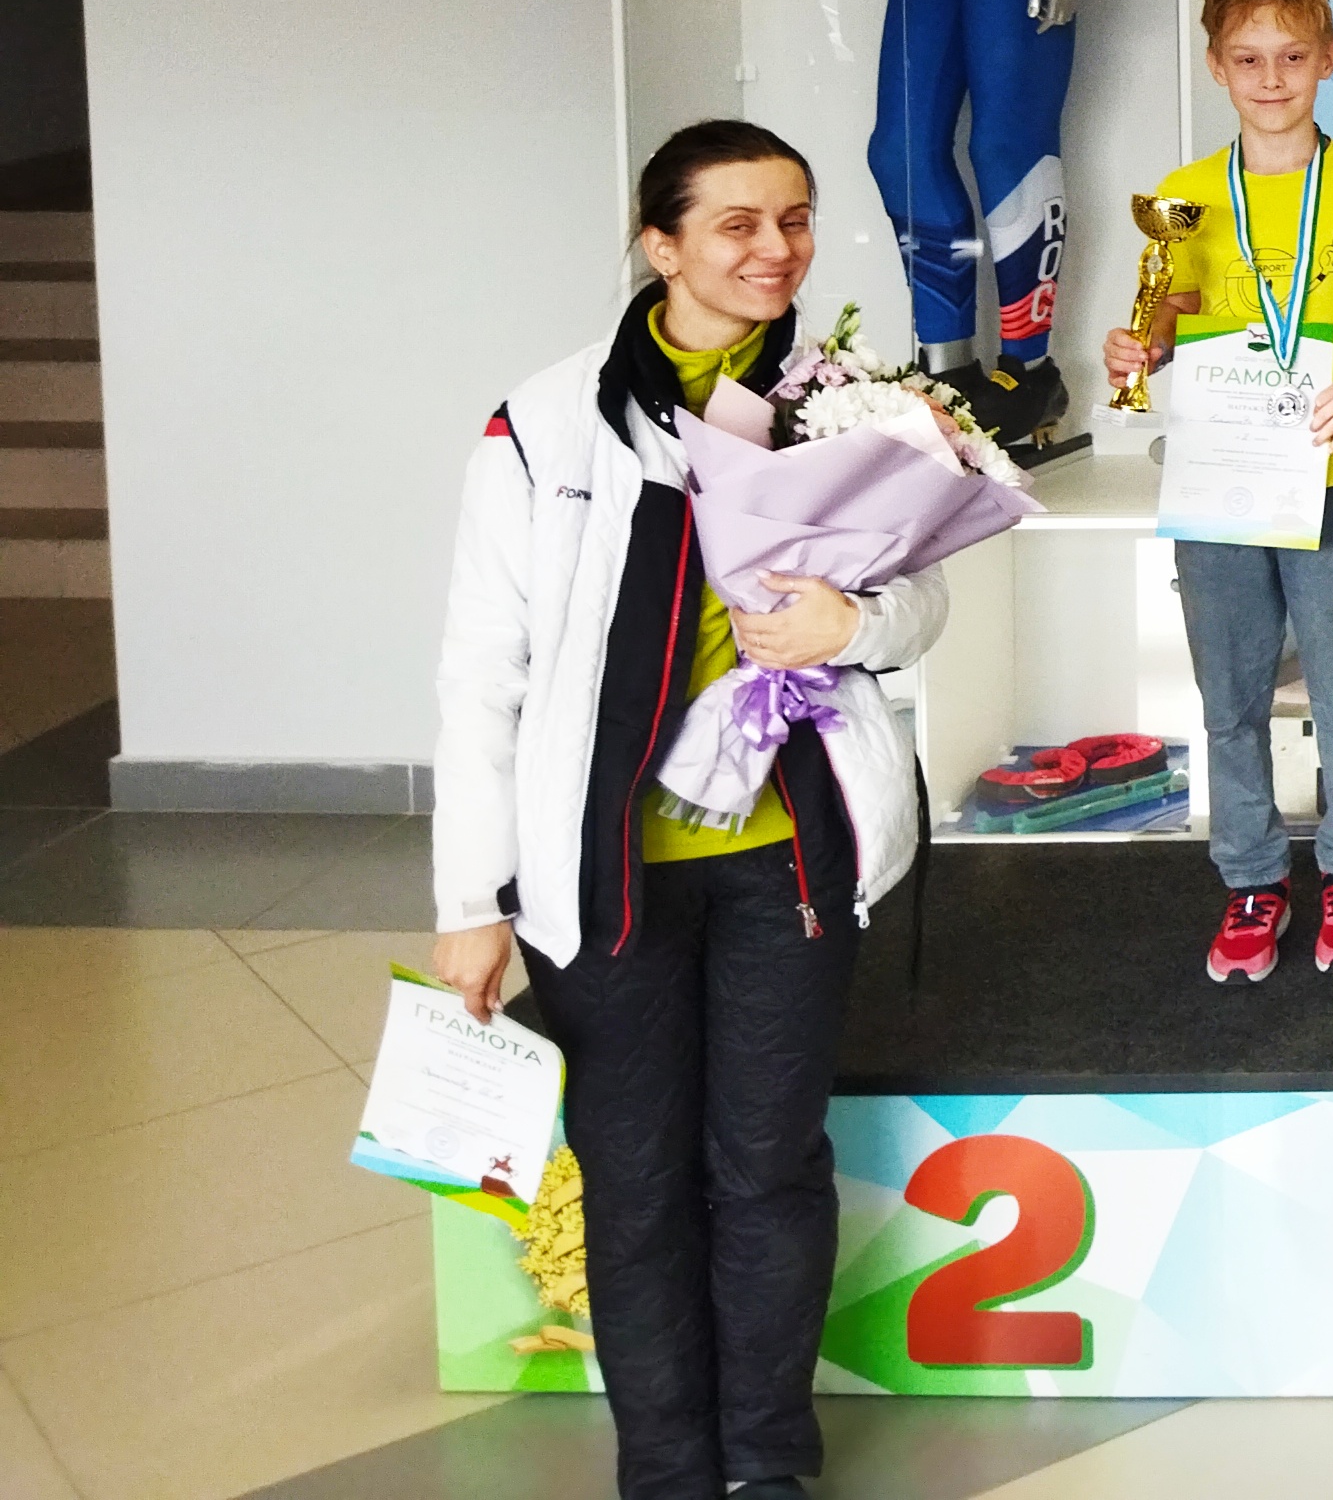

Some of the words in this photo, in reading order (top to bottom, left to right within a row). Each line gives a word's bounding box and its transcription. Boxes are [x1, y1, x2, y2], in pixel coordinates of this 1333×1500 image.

[1195, 365, 1314, 389] ГРАМОТА
[414, 1003, 542, 1066] ГРАМОТА
[904, 1133, 1097, 1370] 2
